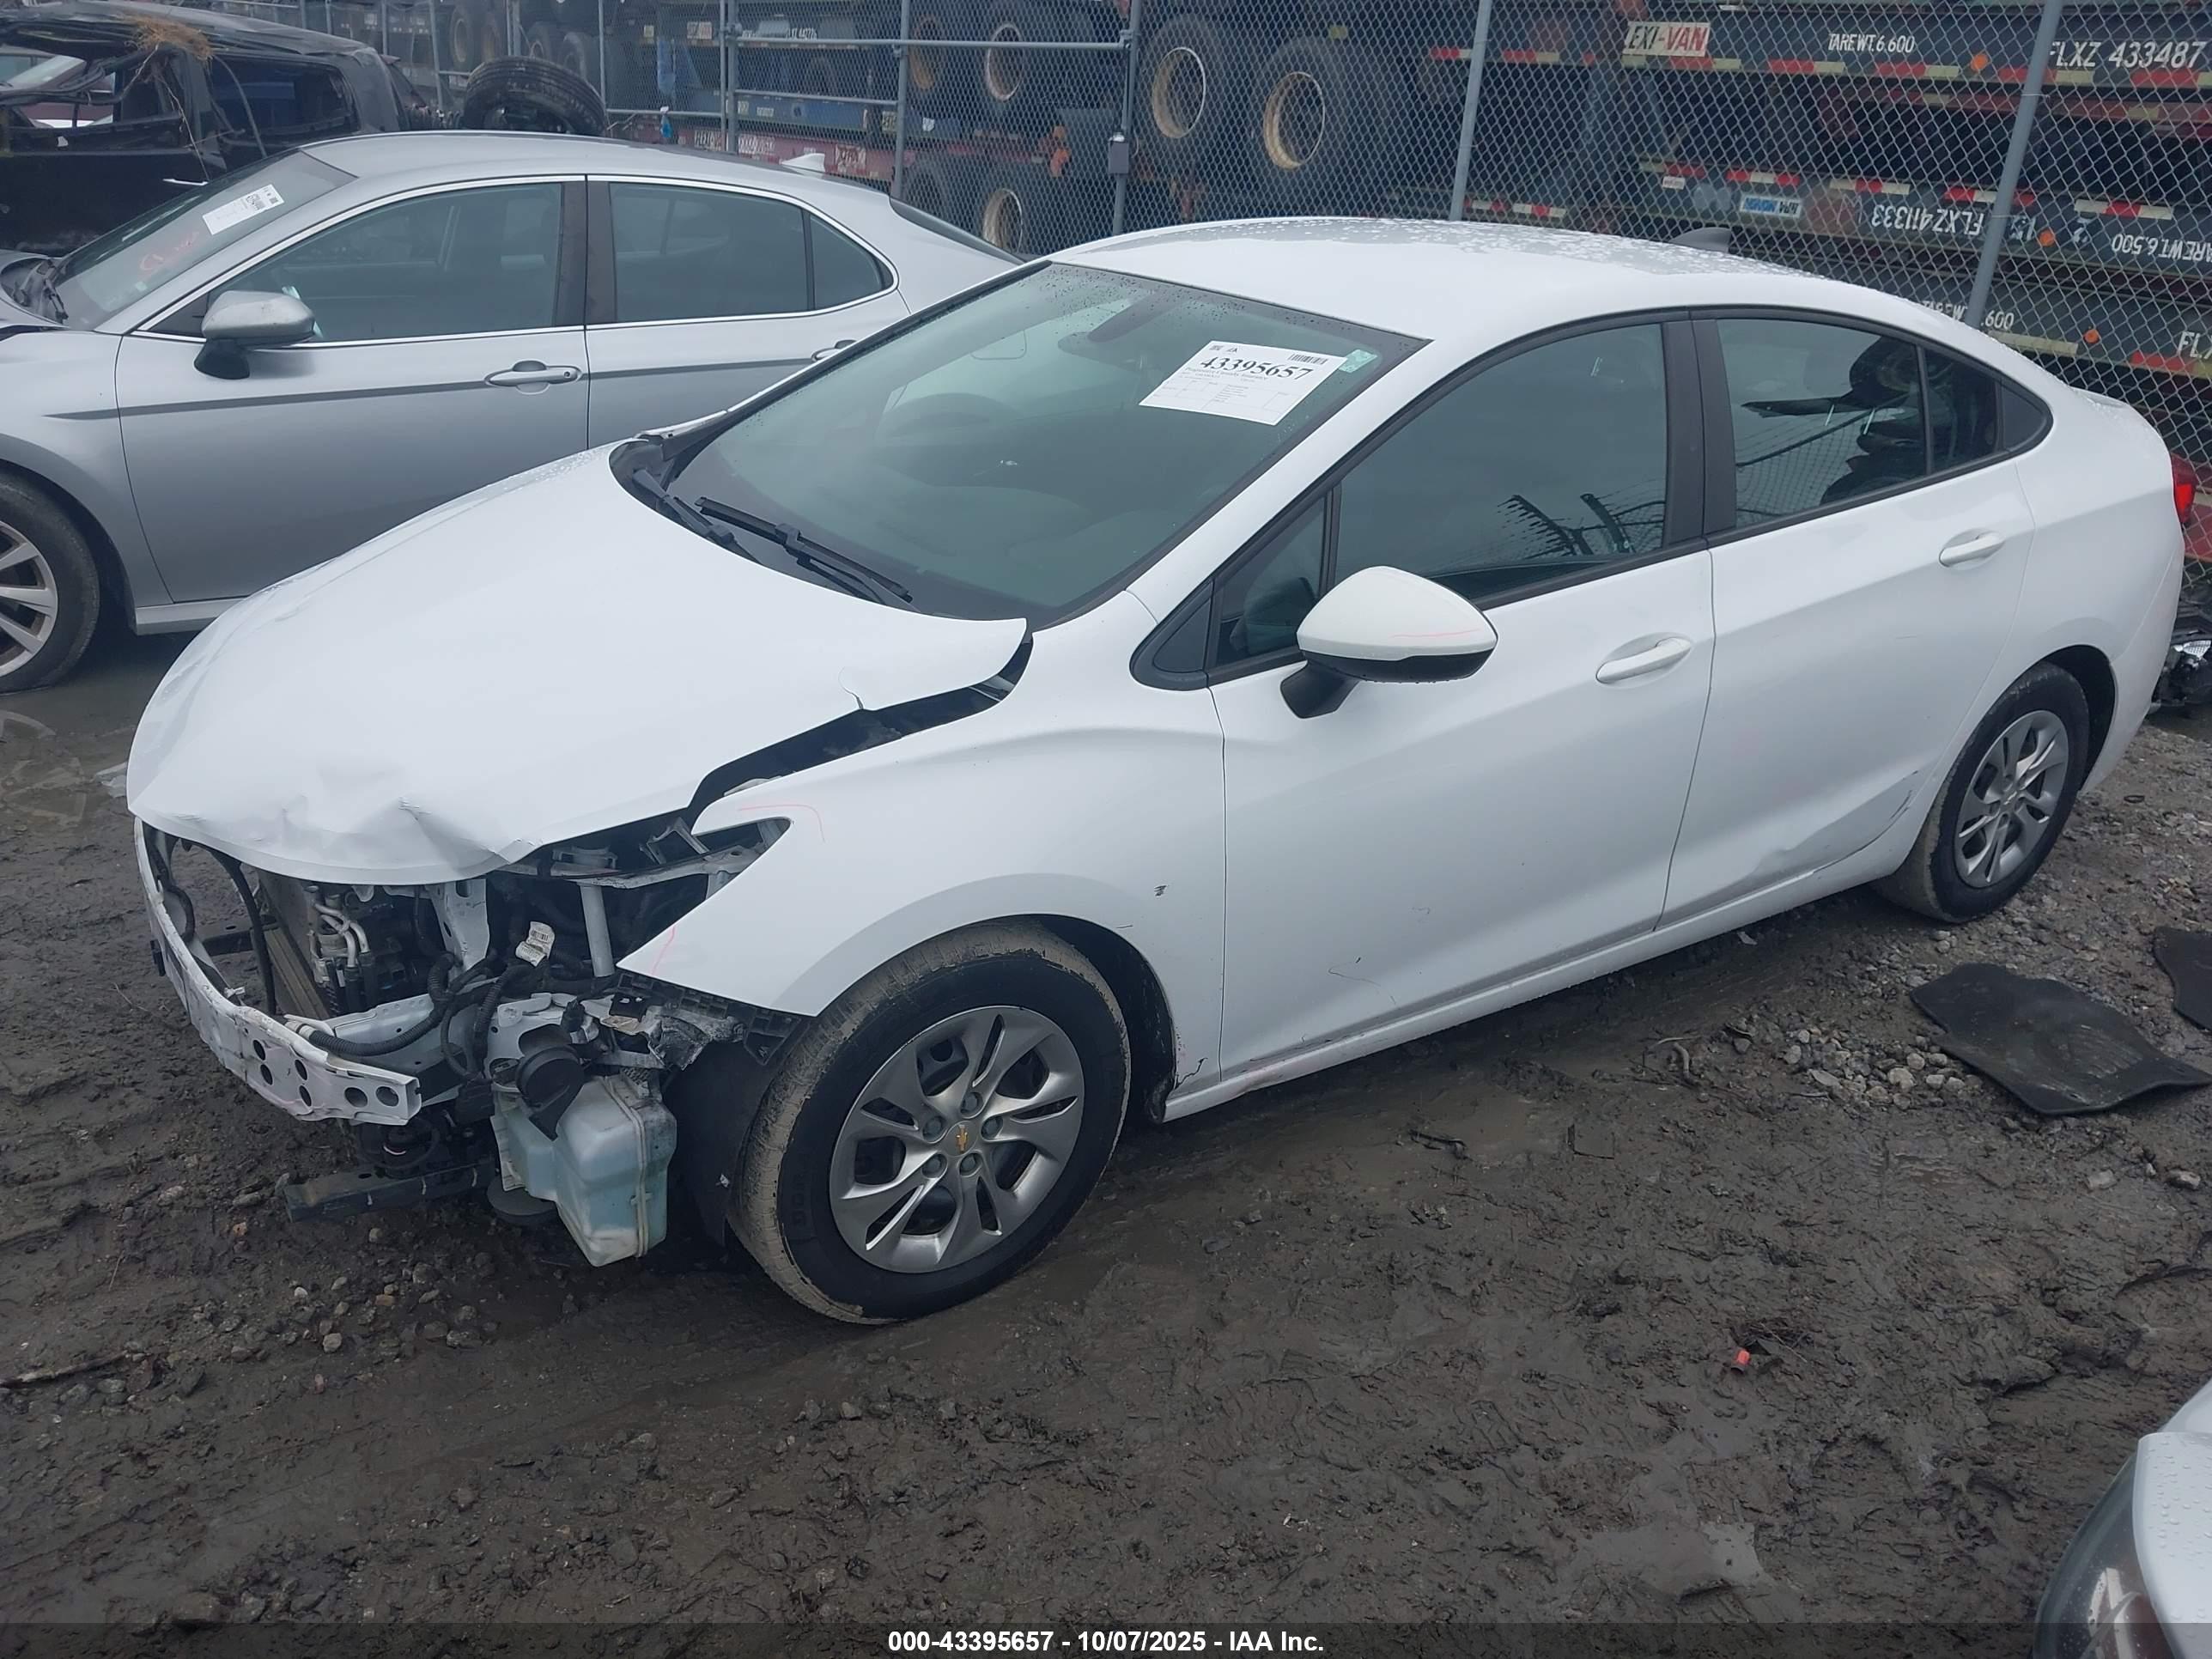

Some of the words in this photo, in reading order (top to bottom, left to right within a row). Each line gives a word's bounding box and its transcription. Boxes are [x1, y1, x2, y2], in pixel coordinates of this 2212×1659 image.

[2108, 41, 2208, 69] 433487
[1871, 204, 1934, 231] 411333
[1932, 209, 1984, 236] FLXZ
[1200, 356, 1314, 380] 43395657
